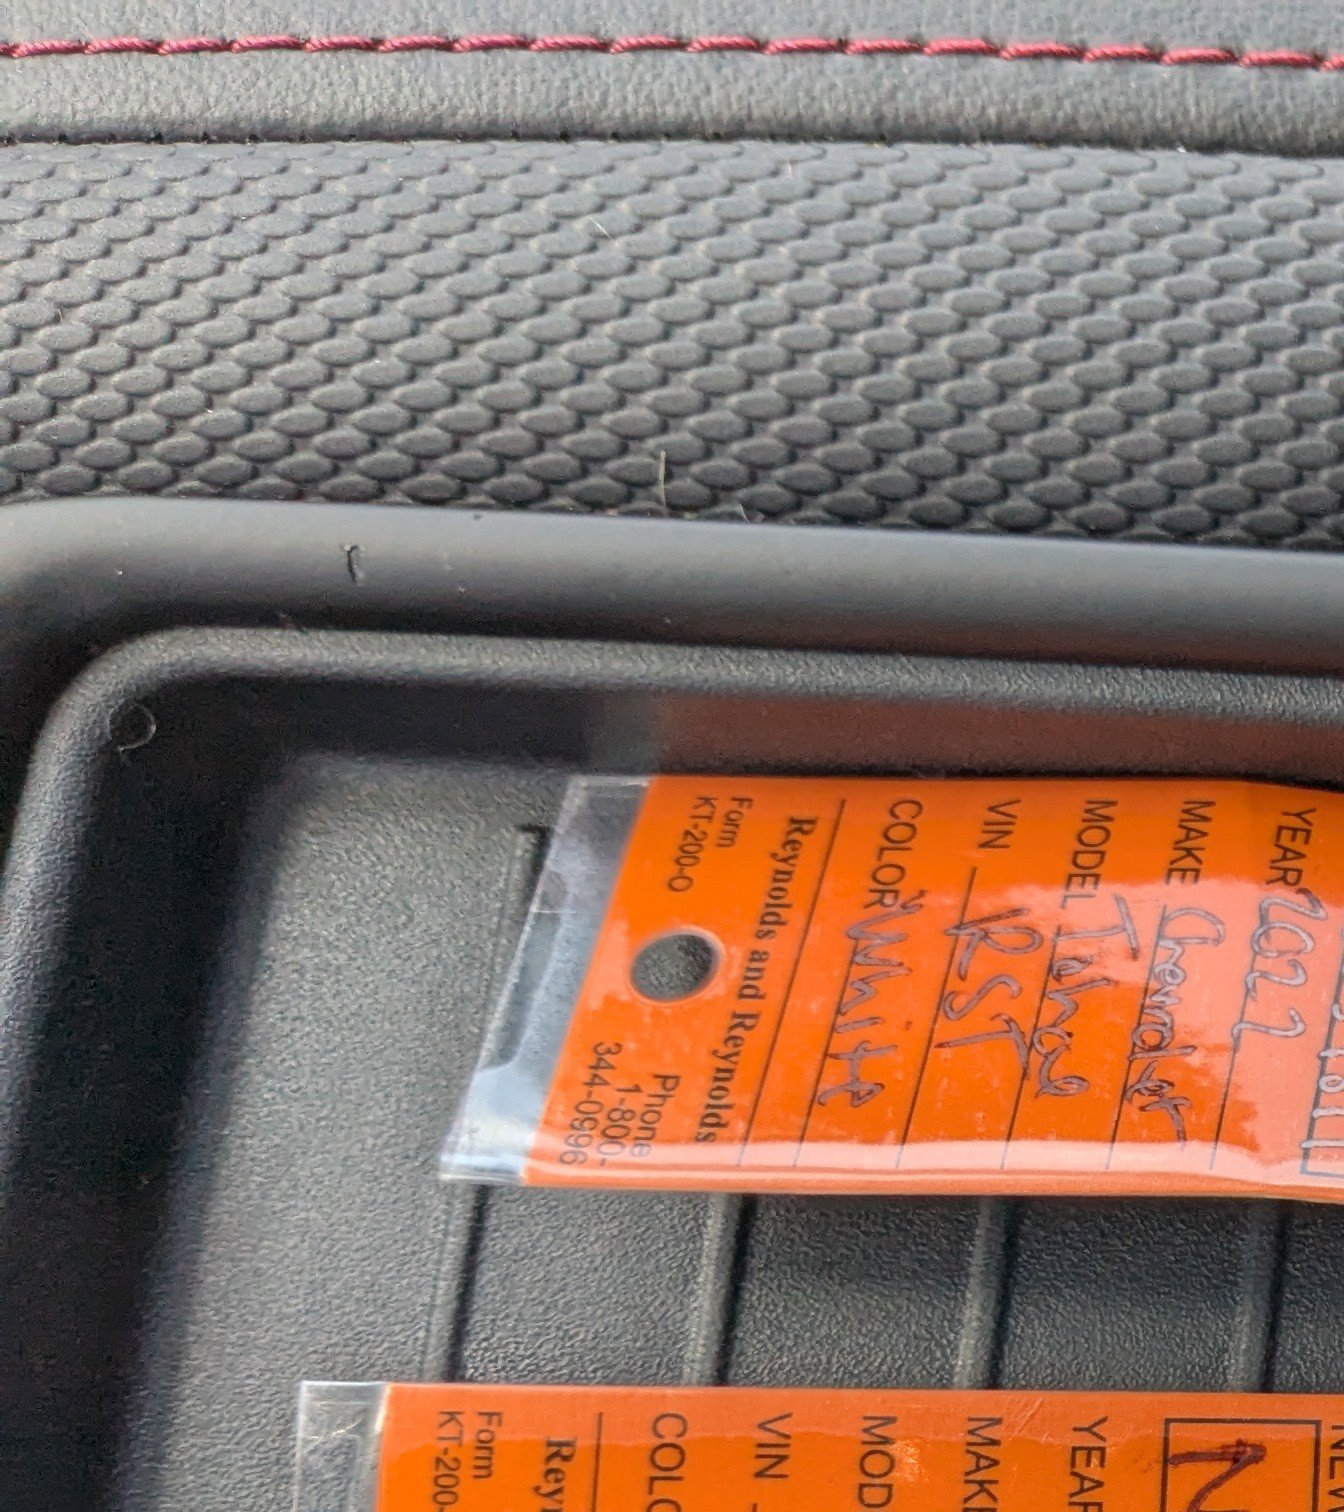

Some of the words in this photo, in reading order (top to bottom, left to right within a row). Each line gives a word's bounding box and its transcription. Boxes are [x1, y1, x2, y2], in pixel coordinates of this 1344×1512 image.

[717, 797, 753, 848] Form
[863, 799, 924, 909] COLOR
[978, 799, 1023, 849] VIN
[1061, 799, 1119, 909] MODEL
[1165, 800, 1217, 886] MAKE
[1266, 808, 1317, 887] YEAR
[755, 817, 819, 940] Reynolds
[737, 950, 771, 1000] and
[818, 890, 927, 1107] White
[934, 908, 1044, 1080] RST
[1232, 889, 1327, 1039] 2022
[558, 1042, 622, 1165] 344-0996
[632, 1074, 681, 1158] Phone
[695, 1011, 761, 1144] Reynolds
[595, 1083, 643, 1167] 1-800-
[472, 1411, 503, 1480] Form
[754, 1412, 792, 1480] VIN
